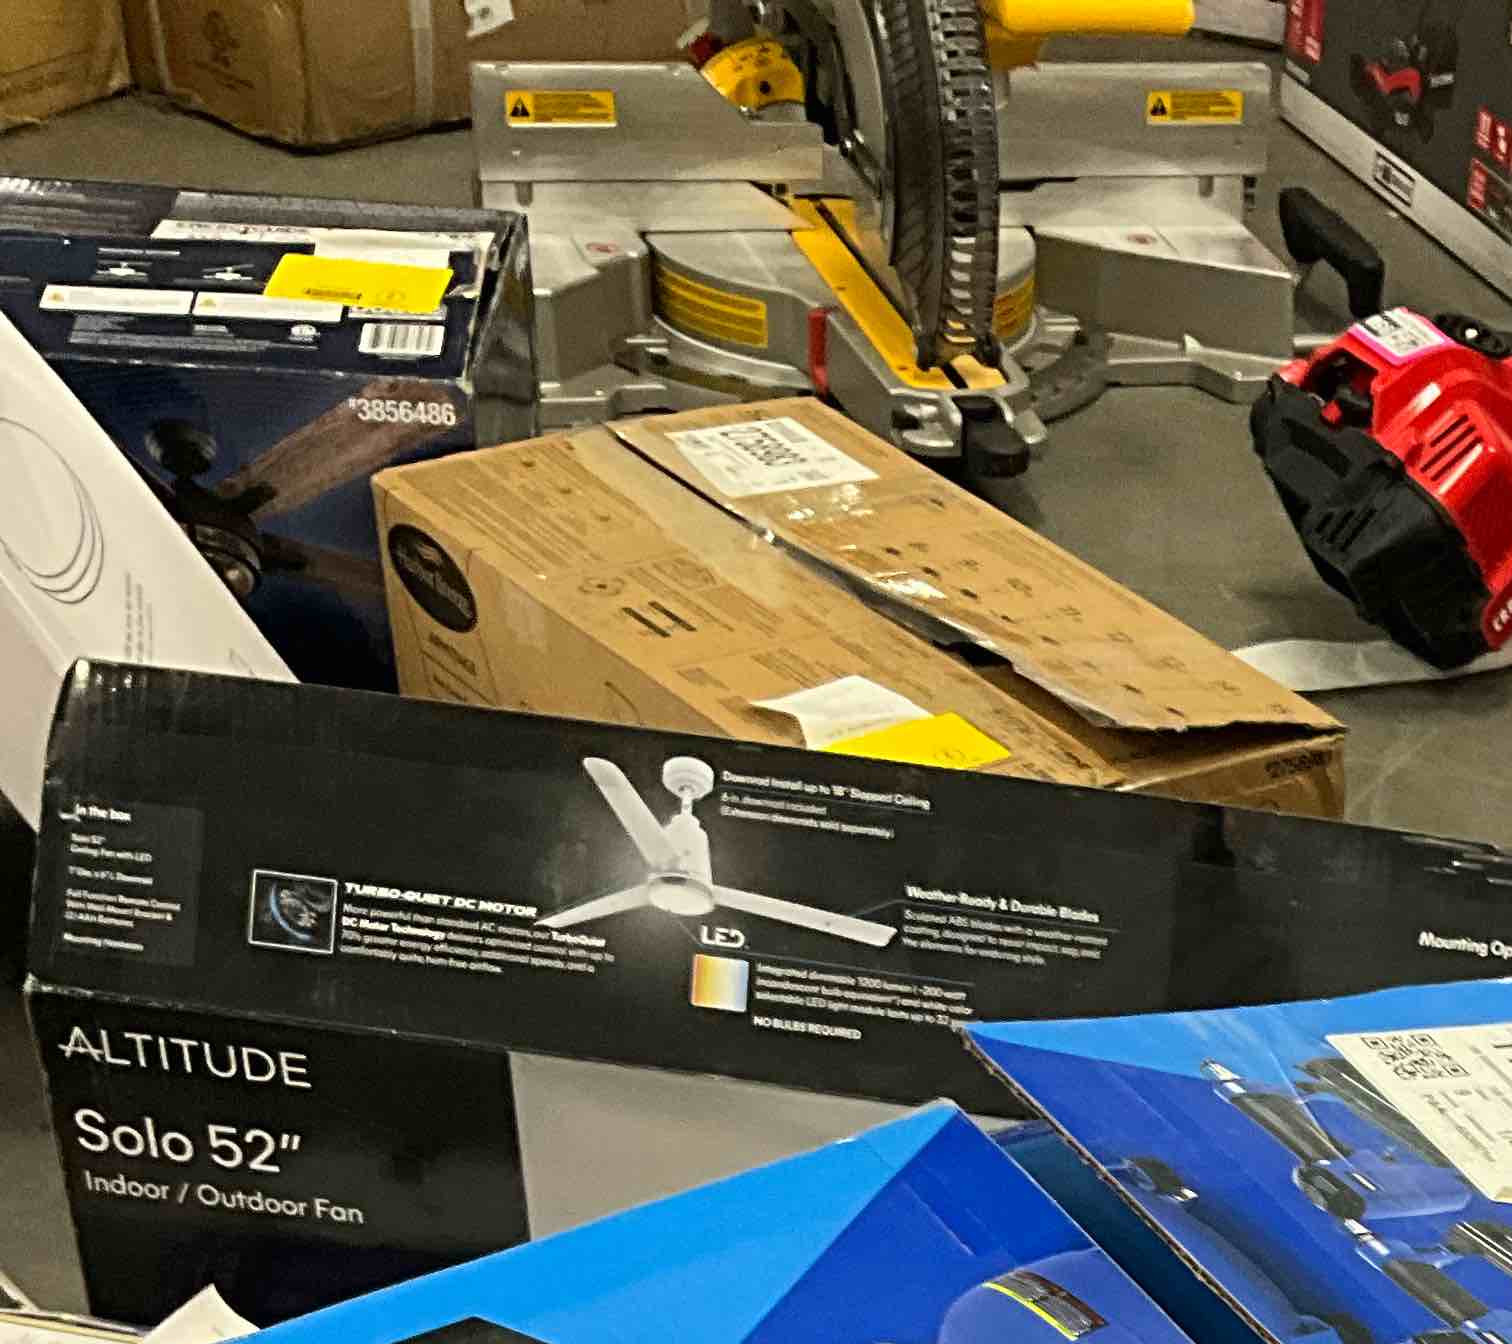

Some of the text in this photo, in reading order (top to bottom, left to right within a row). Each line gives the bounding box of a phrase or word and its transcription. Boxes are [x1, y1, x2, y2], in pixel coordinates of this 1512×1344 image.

[480, 900, 537, 917] MOTOR
[1418, 931, 1489, 957] Mounting
[58, 1025, 312, 1090] ALTITUDE
[75, 1108, 193, 1163] Solo
[86, 1170, 168, 1201] Indoor
[198, 1183, 307, 1218] Outdoor
[315, 1197, 364, 1226] Fan
